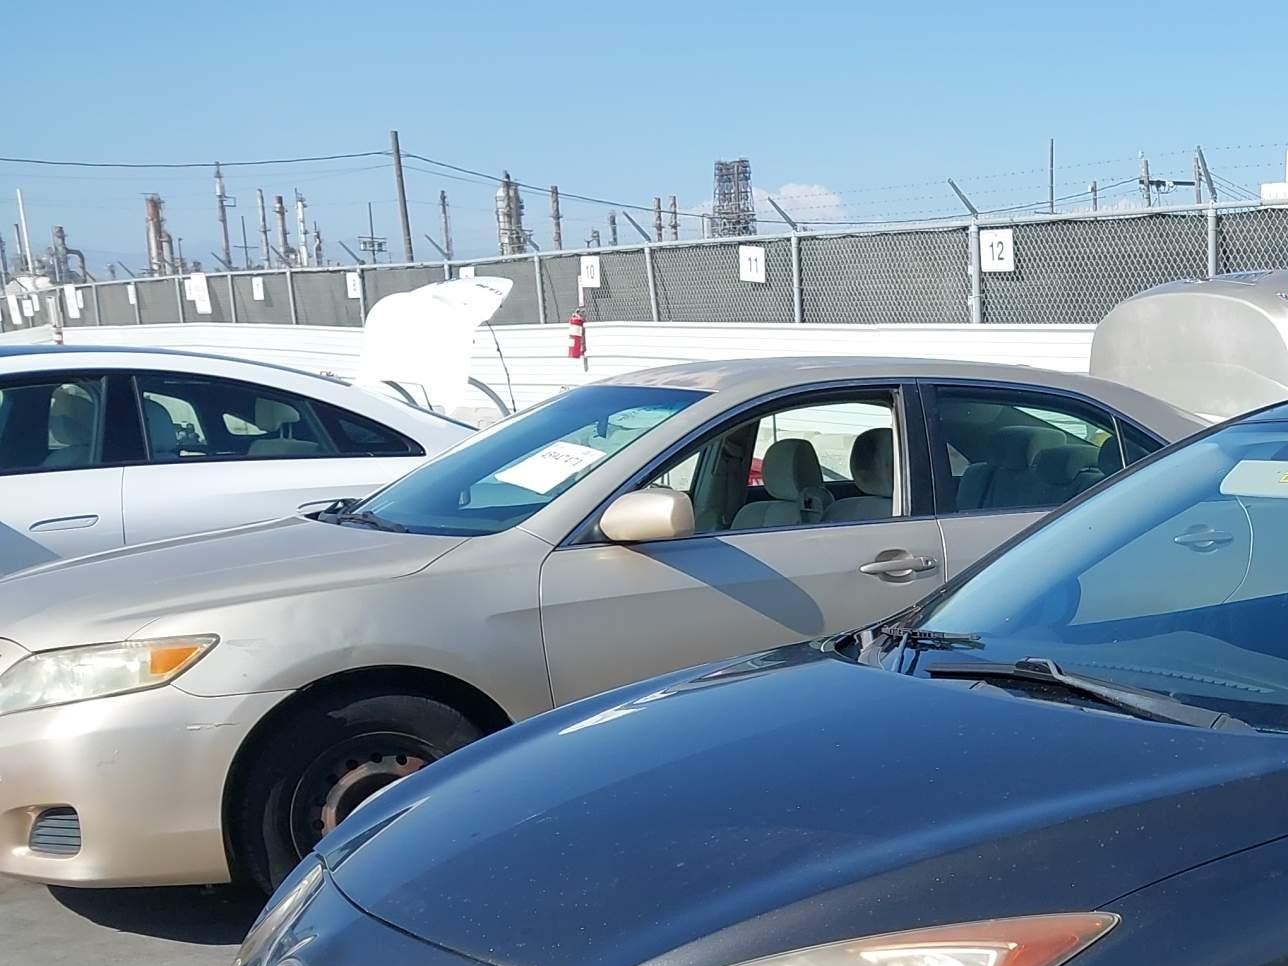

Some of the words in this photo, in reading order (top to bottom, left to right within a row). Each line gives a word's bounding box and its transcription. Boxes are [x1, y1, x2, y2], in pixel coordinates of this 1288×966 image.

[989, 241, 1005, 261] 12
[585, 264, 595, 279] 10
[748, 256, 758, 272] 11
